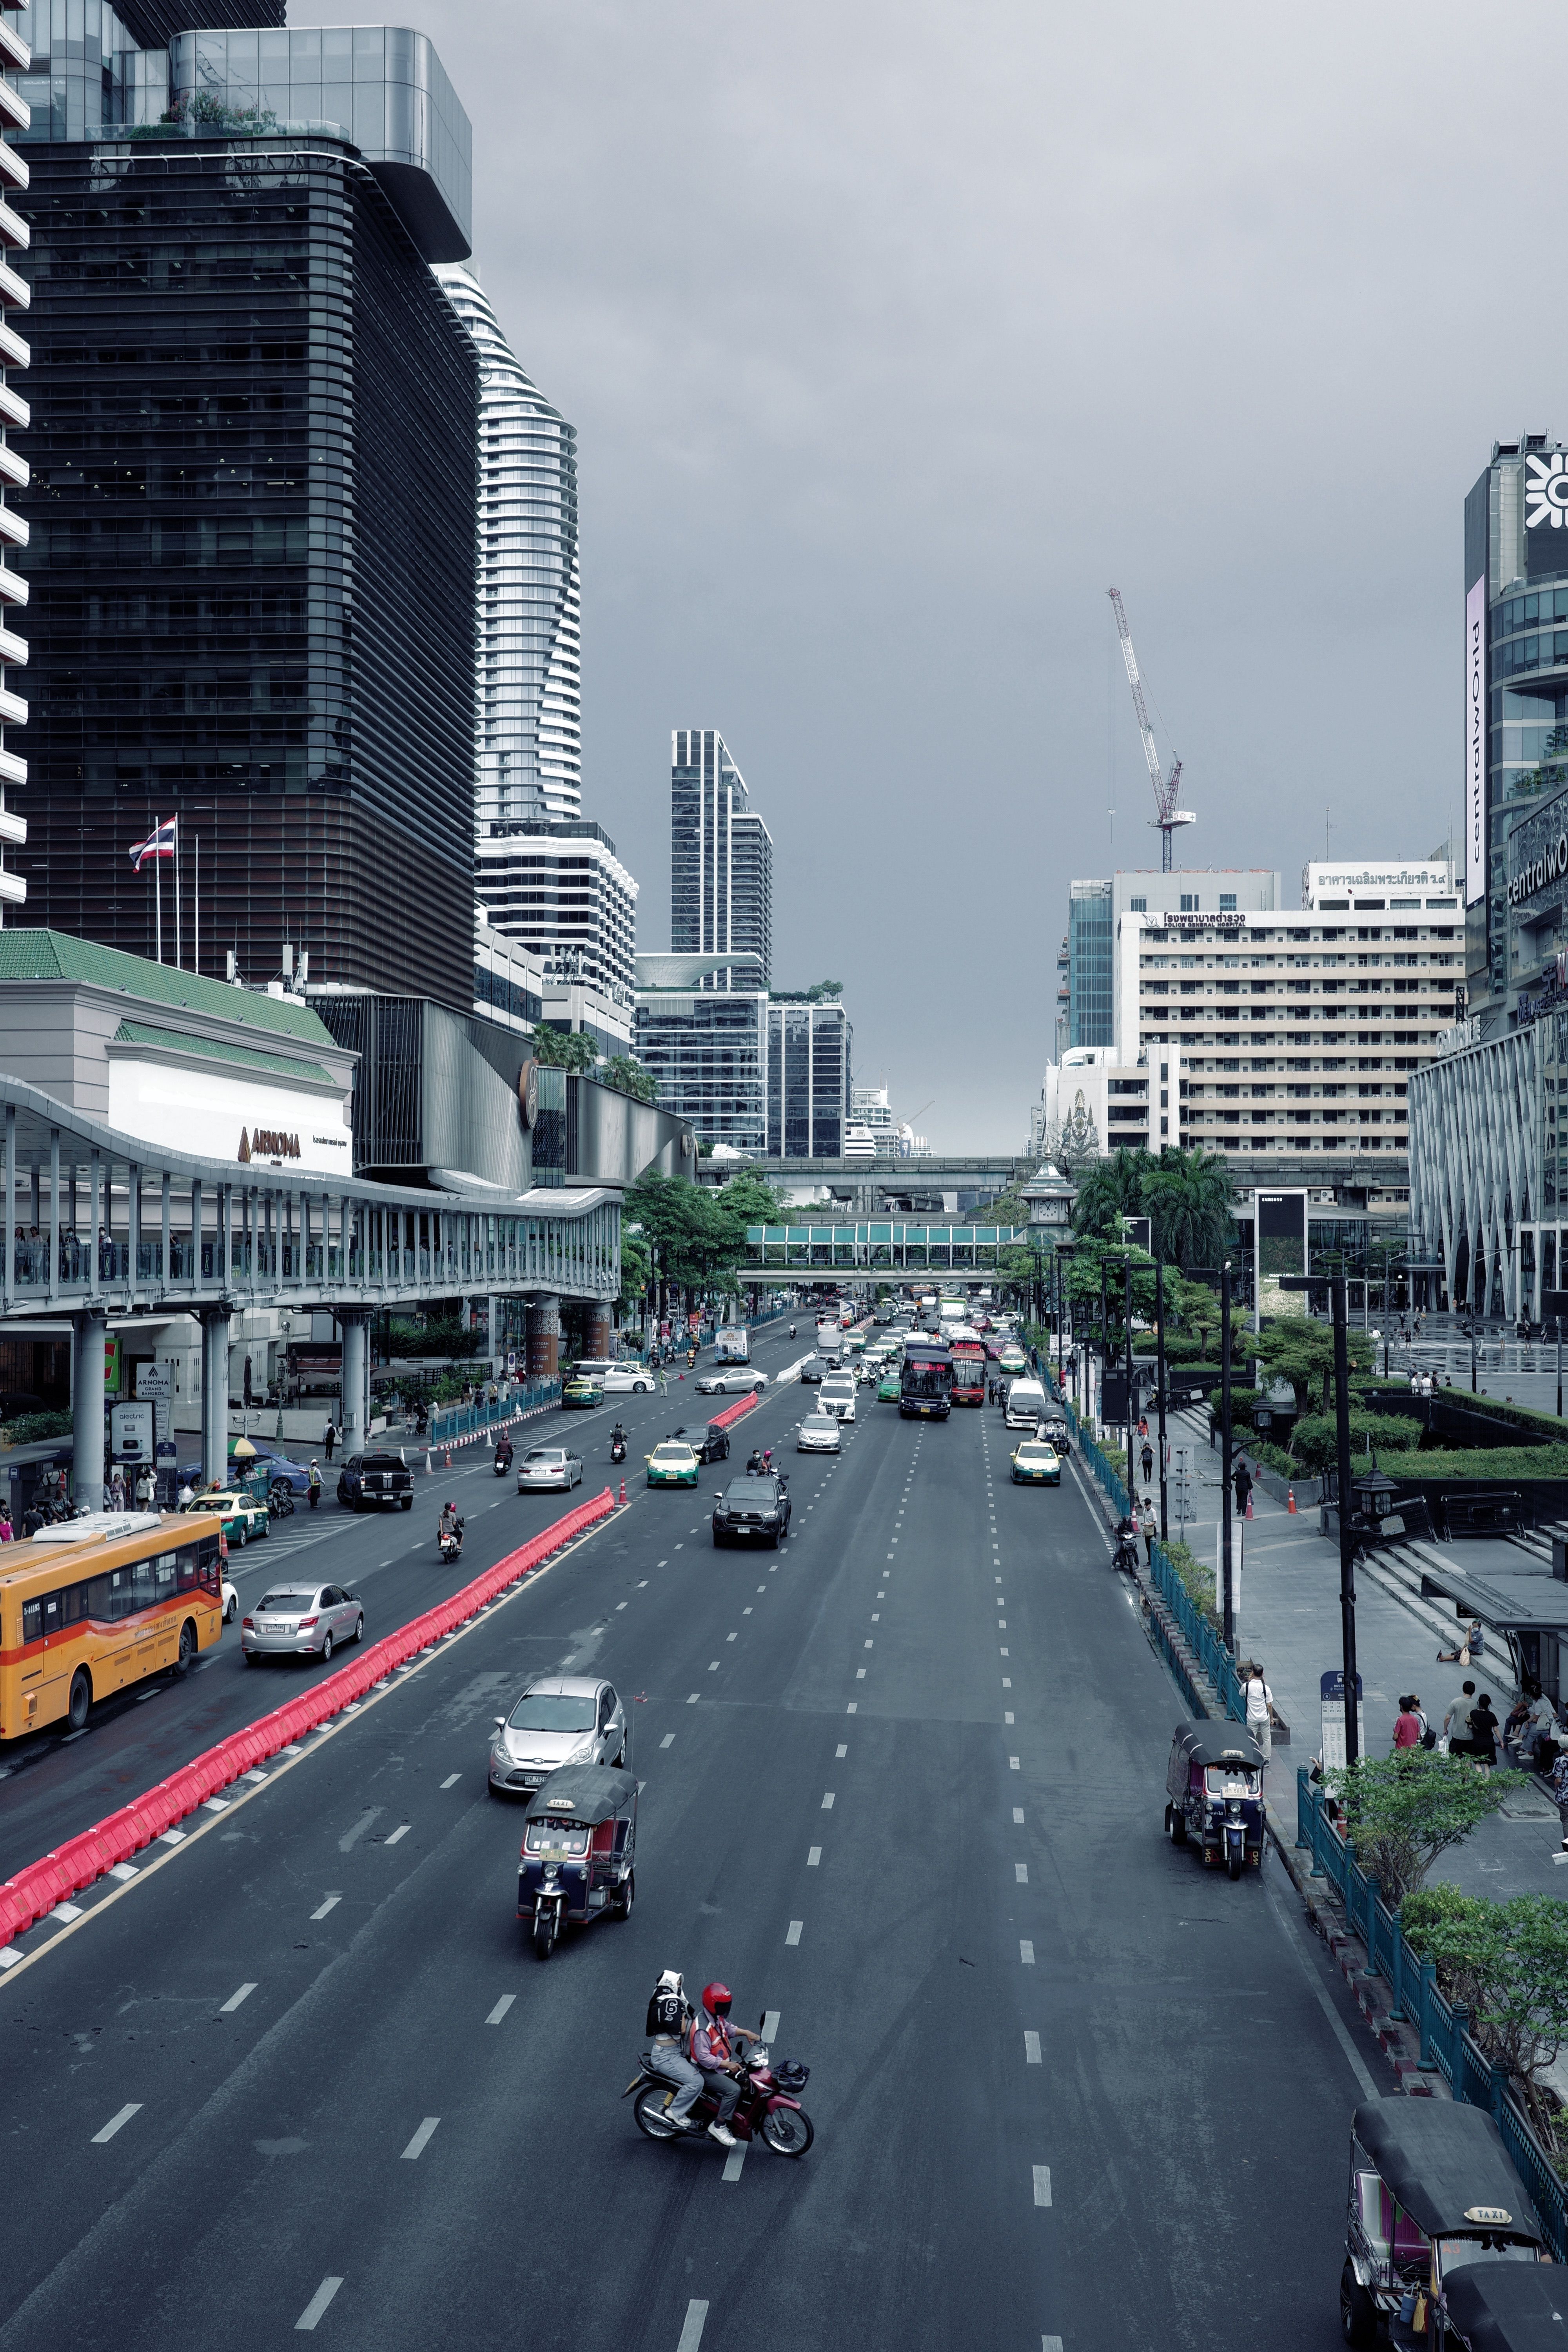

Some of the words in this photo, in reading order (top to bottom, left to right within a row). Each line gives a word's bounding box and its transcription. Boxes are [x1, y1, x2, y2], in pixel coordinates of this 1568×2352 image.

[1318, 871, 1428, 885] อาคารเฉลิมพระเกียรติ
[1164, 912, 1246, 922] โรงพยาบาลตำรวจ
[251, 1128, 301, 1158] ARNOMA
[665, 1999, 678, 2014] 6
[1477, 2210, 1503, 2219] TAXI
[1442, 2243, 1461, 2254] A3
